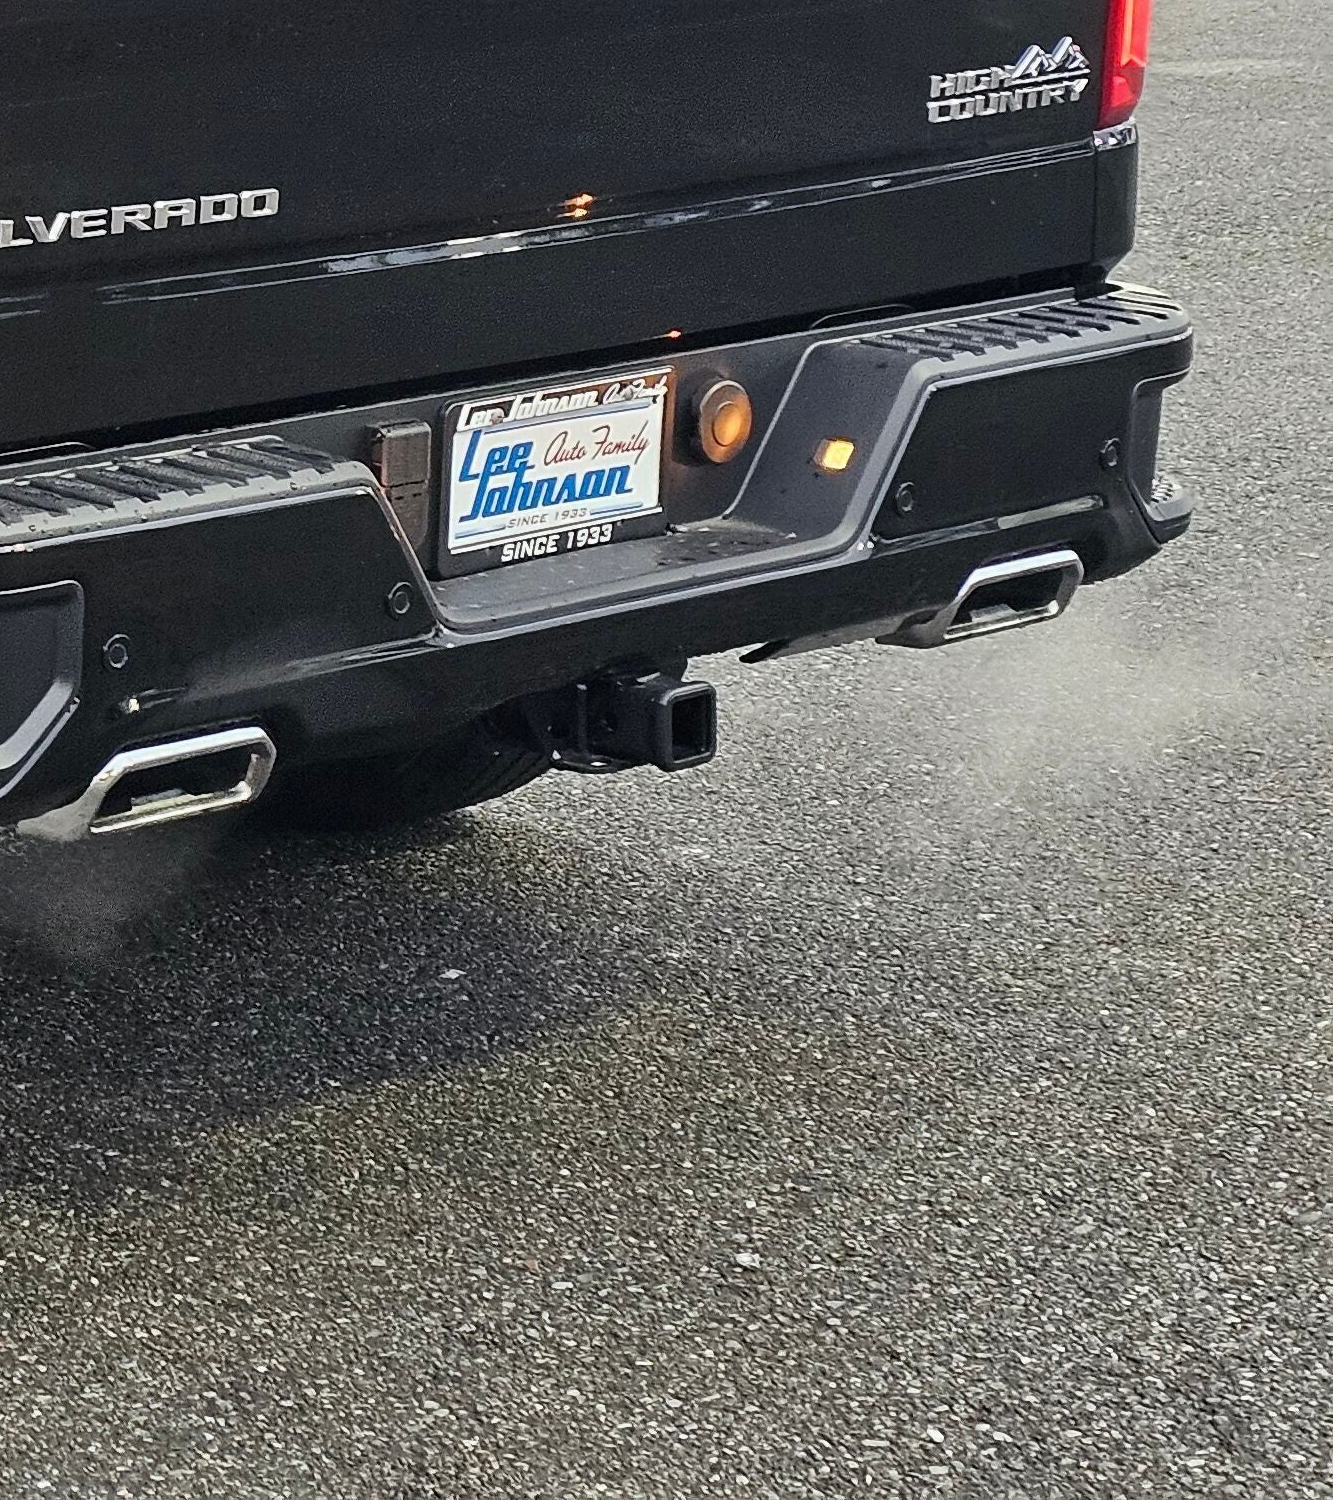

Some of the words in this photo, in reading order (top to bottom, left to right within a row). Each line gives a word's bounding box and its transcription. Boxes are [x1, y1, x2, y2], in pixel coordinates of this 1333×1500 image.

[929, 65, 1015, 98] HIGH
[926, 79, 1089, 124] COUNTRY
[503, 390, 600, 422] Johnson
[459, 430, 535, 482] Lee
[544, 431, 586, 466] Auto
[591, 419, 649, 465] Family
[459, 460, 634, 523] Johnson
[507, 512, 547, 528] SINCE
[554, 508, 588, 521] 1933
[501, 534, 560, 562] SINCE
[566, 524, 613, 550] 1933
